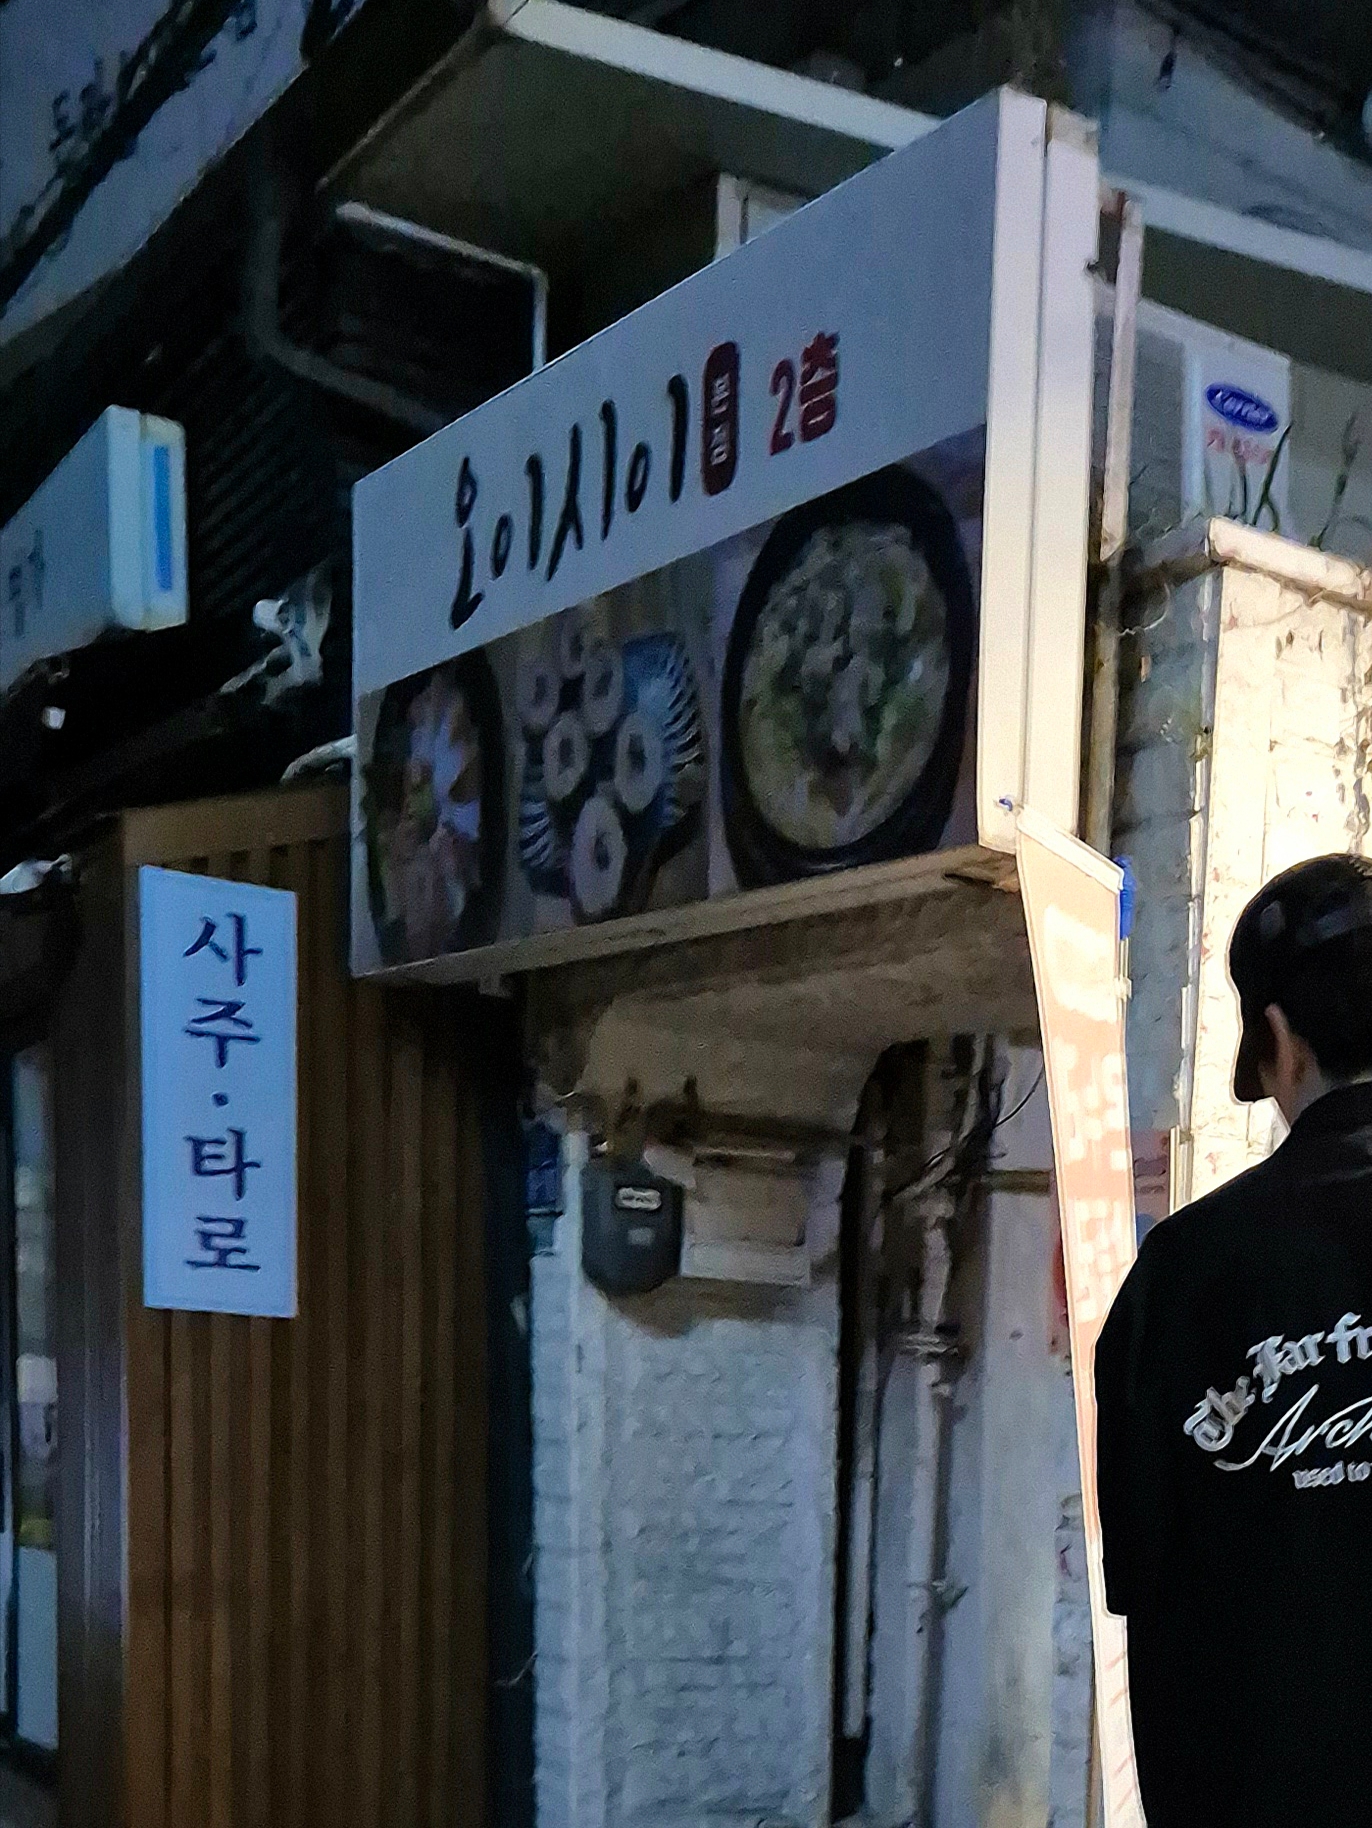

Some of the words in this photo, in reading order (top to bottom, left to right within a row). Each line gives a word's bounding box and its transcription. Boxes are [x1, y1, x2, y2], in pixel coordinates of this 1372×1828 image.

[450, 373, 690, 630] 오이시이
[769, 331, 839, 456] 2층
[1245, 1334, 1326, 1403] Far
